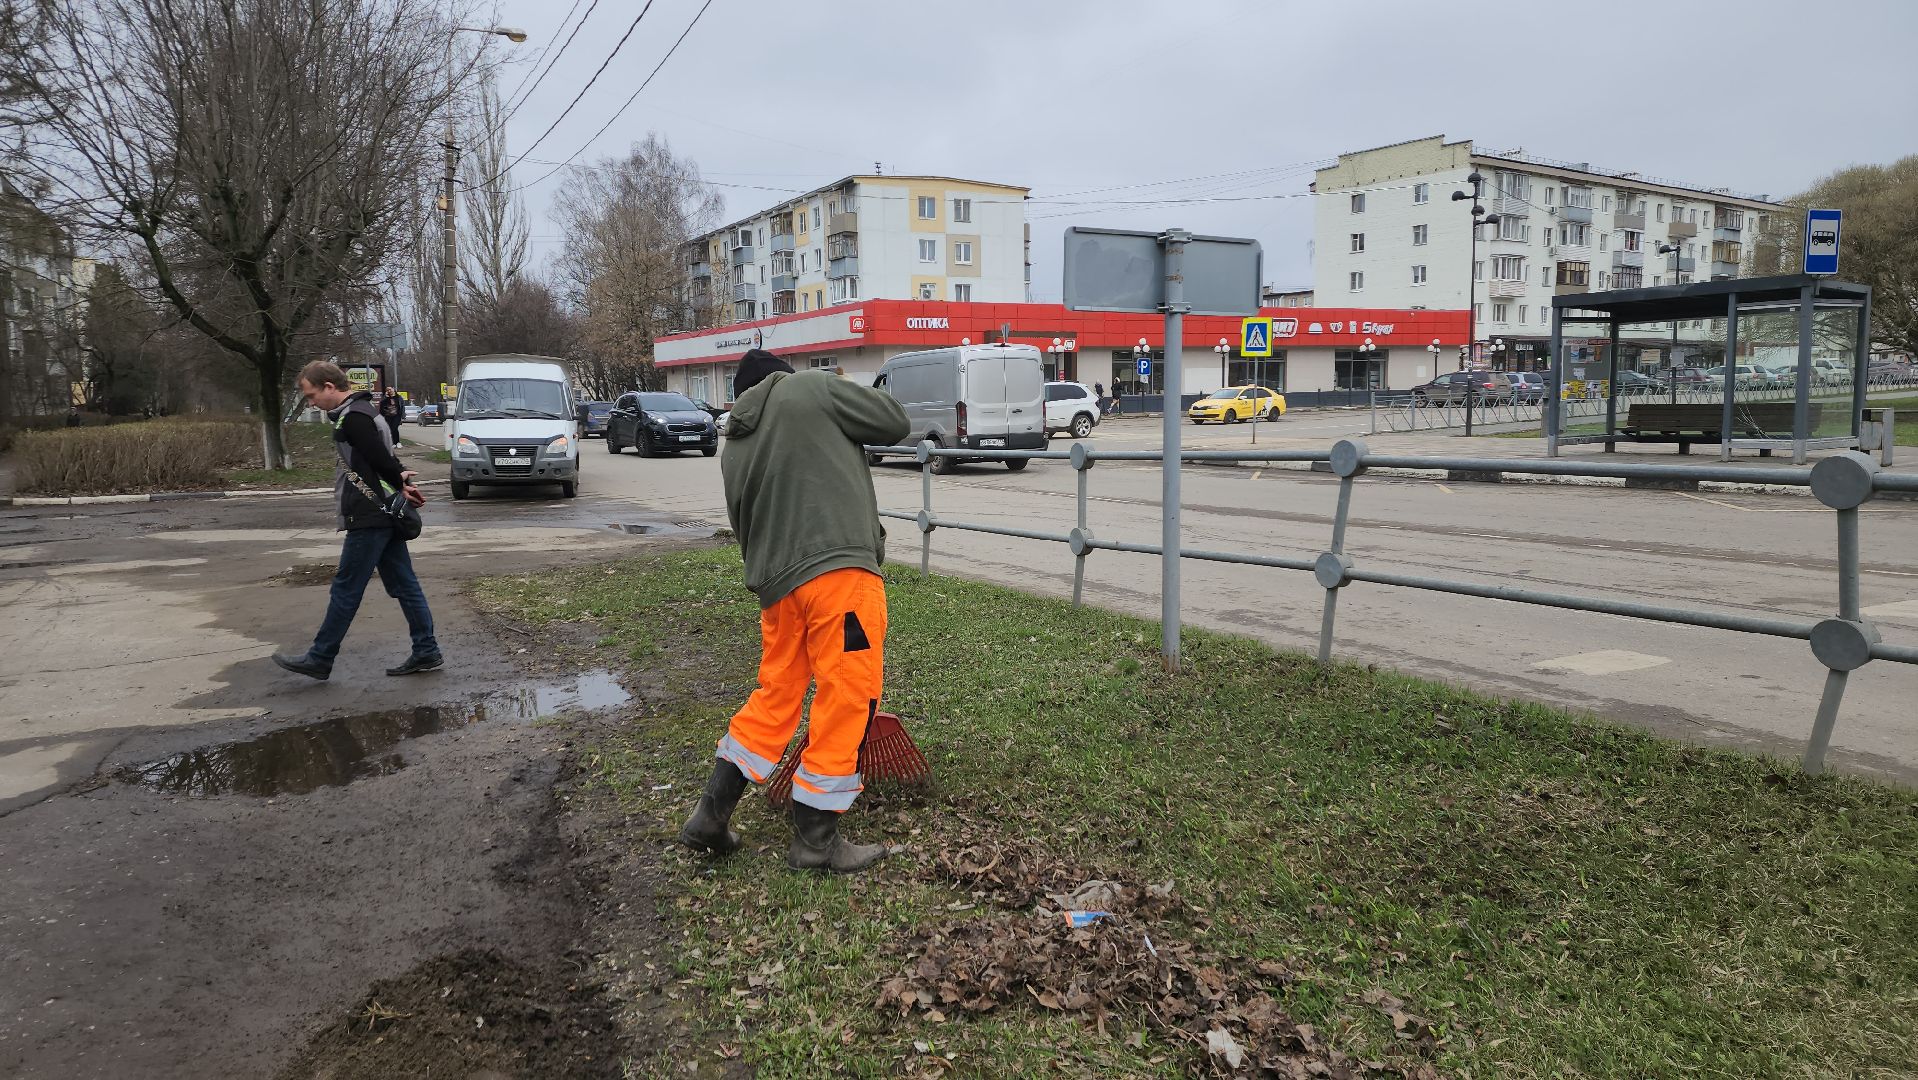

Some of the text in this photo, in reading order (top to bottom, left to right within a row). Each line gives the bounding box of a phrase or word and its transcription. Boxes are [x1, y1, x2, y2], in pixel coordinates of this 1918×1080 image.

[906, 317, 949, 329] ОПТИКА
[1140, 360, 1148, 373] P
[349, 372, 376, 380] КОСТЛ
